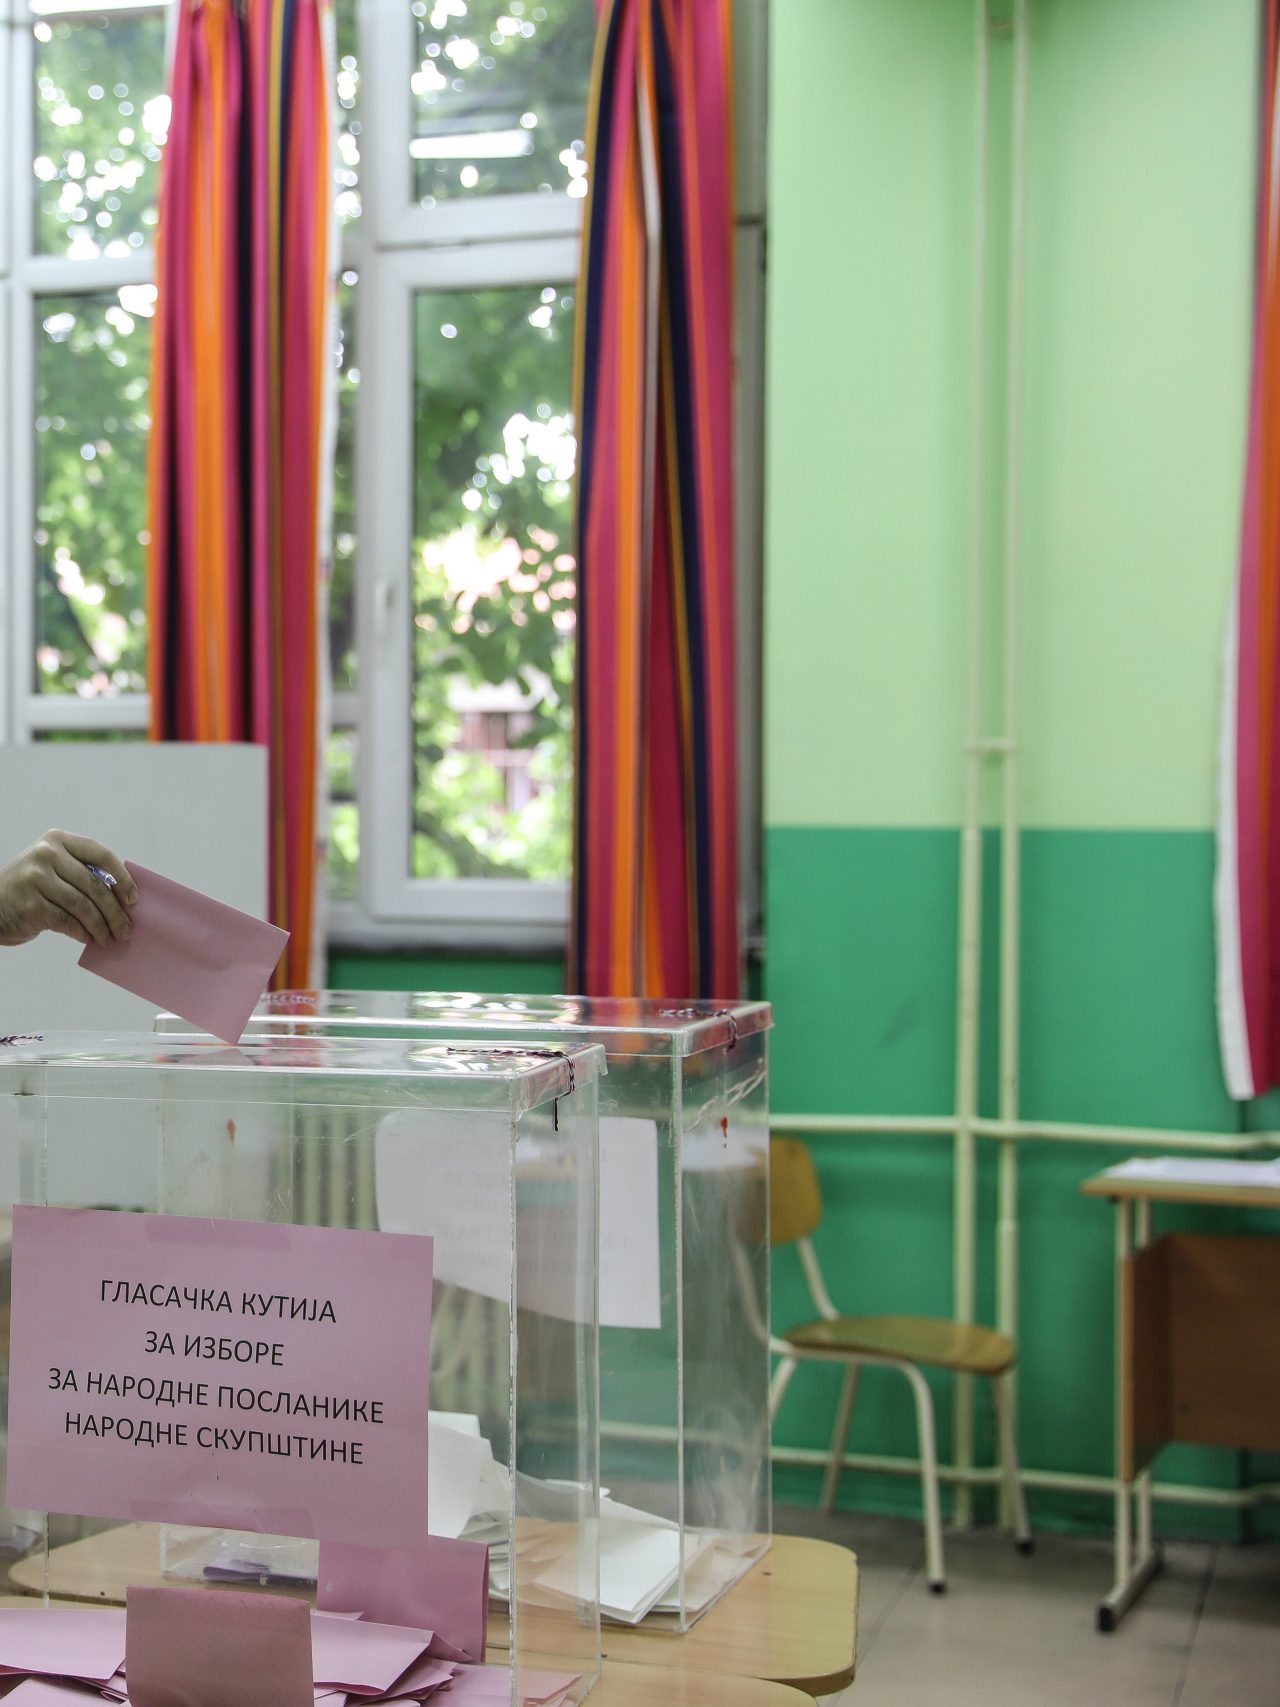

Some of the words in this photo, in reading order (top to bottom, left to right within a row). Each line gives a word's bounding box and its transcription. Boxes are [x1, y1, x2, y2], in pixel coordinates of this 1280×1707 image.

[100, 1279, 233, 1314] ГЛАСАЧКА
[241, 1292, 337, 1324] КУТИЈА
[144, 1330, 176, 1356] ЗА
[184, 1334, 285, 1367] ИЗБОРЕ
[48, 1367, 78, 1392] ЗА
[86, 1371, 209, 1408] НАРОДНЕ
[218, 1385, 384, 1424] ПОСЛАНИКЕ
[65, 1411, 188, 1448] НАРОДНЕ
[196, 1426, 364, 1465] СКУПШТИНЕ
